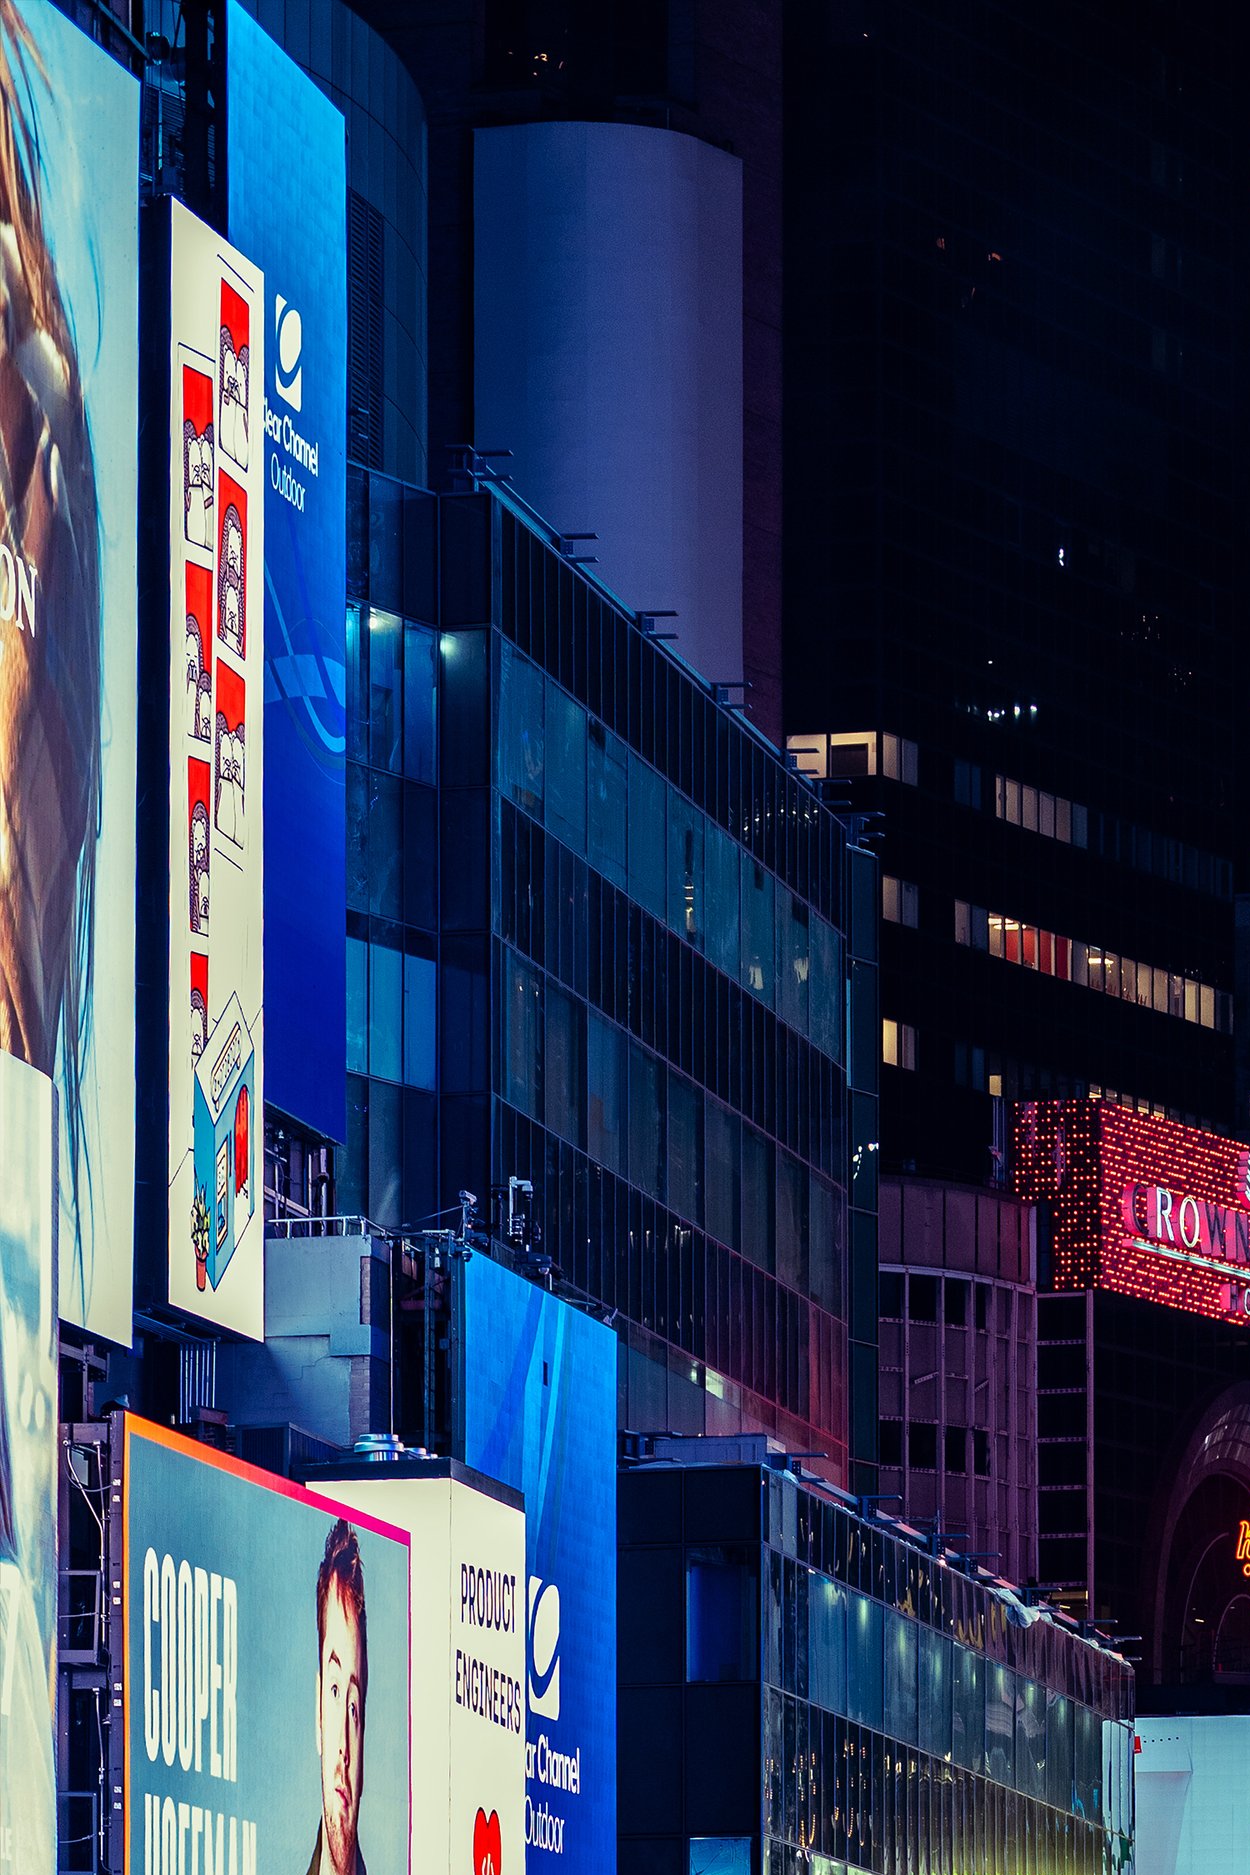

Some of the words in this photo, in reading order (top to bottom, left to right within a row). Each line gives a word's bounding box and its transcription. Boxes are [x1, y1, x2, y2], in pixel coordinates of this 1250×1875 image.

[264, 397, 282, 443] lear
[283, 415, 318, 477] Channel
[271, 452, 305, 512] Outdoor
[461, 1563, 516, 1634] PRODUCT
[143, 1547, 238, 1782] COOPER
[456, 1649, 521, 1734] ENGINEERS
[538, 1734, 580, 1794] Channel
[525, 1796, 565, 1854] Outdoor
